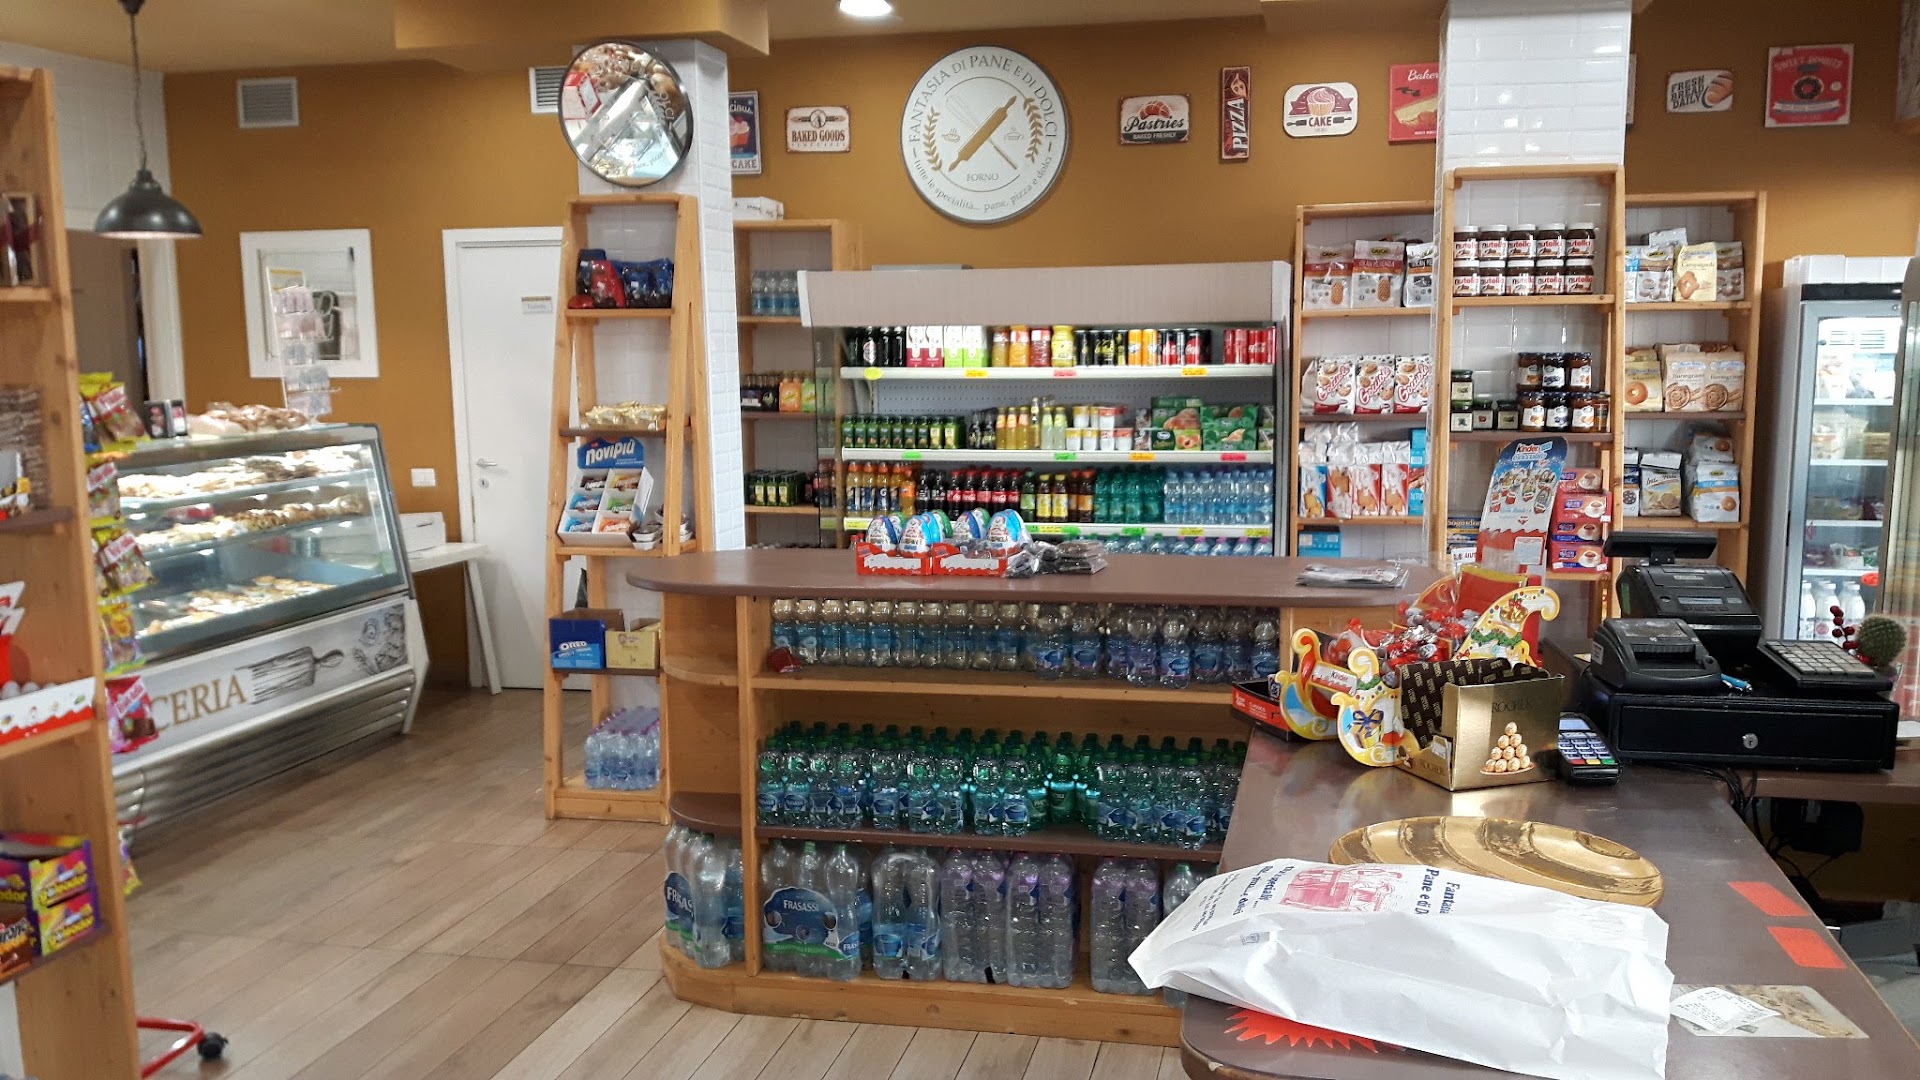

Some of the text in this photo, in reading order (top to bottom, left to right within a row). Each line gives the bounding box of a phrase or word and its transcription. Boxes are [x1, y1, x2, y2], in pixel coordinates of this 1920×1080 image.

[1407, 69, 1440, 82] Baker
[1671, 75, 1705, 92] FRESH
[908, 54, 1058, 143] FANTASIA DI PANE E DI DOLCI
[1671, 85, 1705, 102] BREAD
[729, 100, 754, 115] cious
[1673, 94, 1702, 109] DAILY
[1123, 115, 1185, 132] Pastries
[1227, 98, 1249, 150] PIZZA
[1308, 116, 1332, 127] CAKE
[791, 129, 846, 142] BAKED GOODS
[1153, 131, 1177, 139] FRESHLY
[731, 159, 758, 169] CAKE
[966, 173, 999, 182] FORNO
[1010, 183, 1033, 207] pizza
[560, 641, 588, 651] OREO
[151, 674, 248, 732] CERIA
[1421, 868, 1440, 892] Pane
[783, 899, 820, 912] FRASASSI
